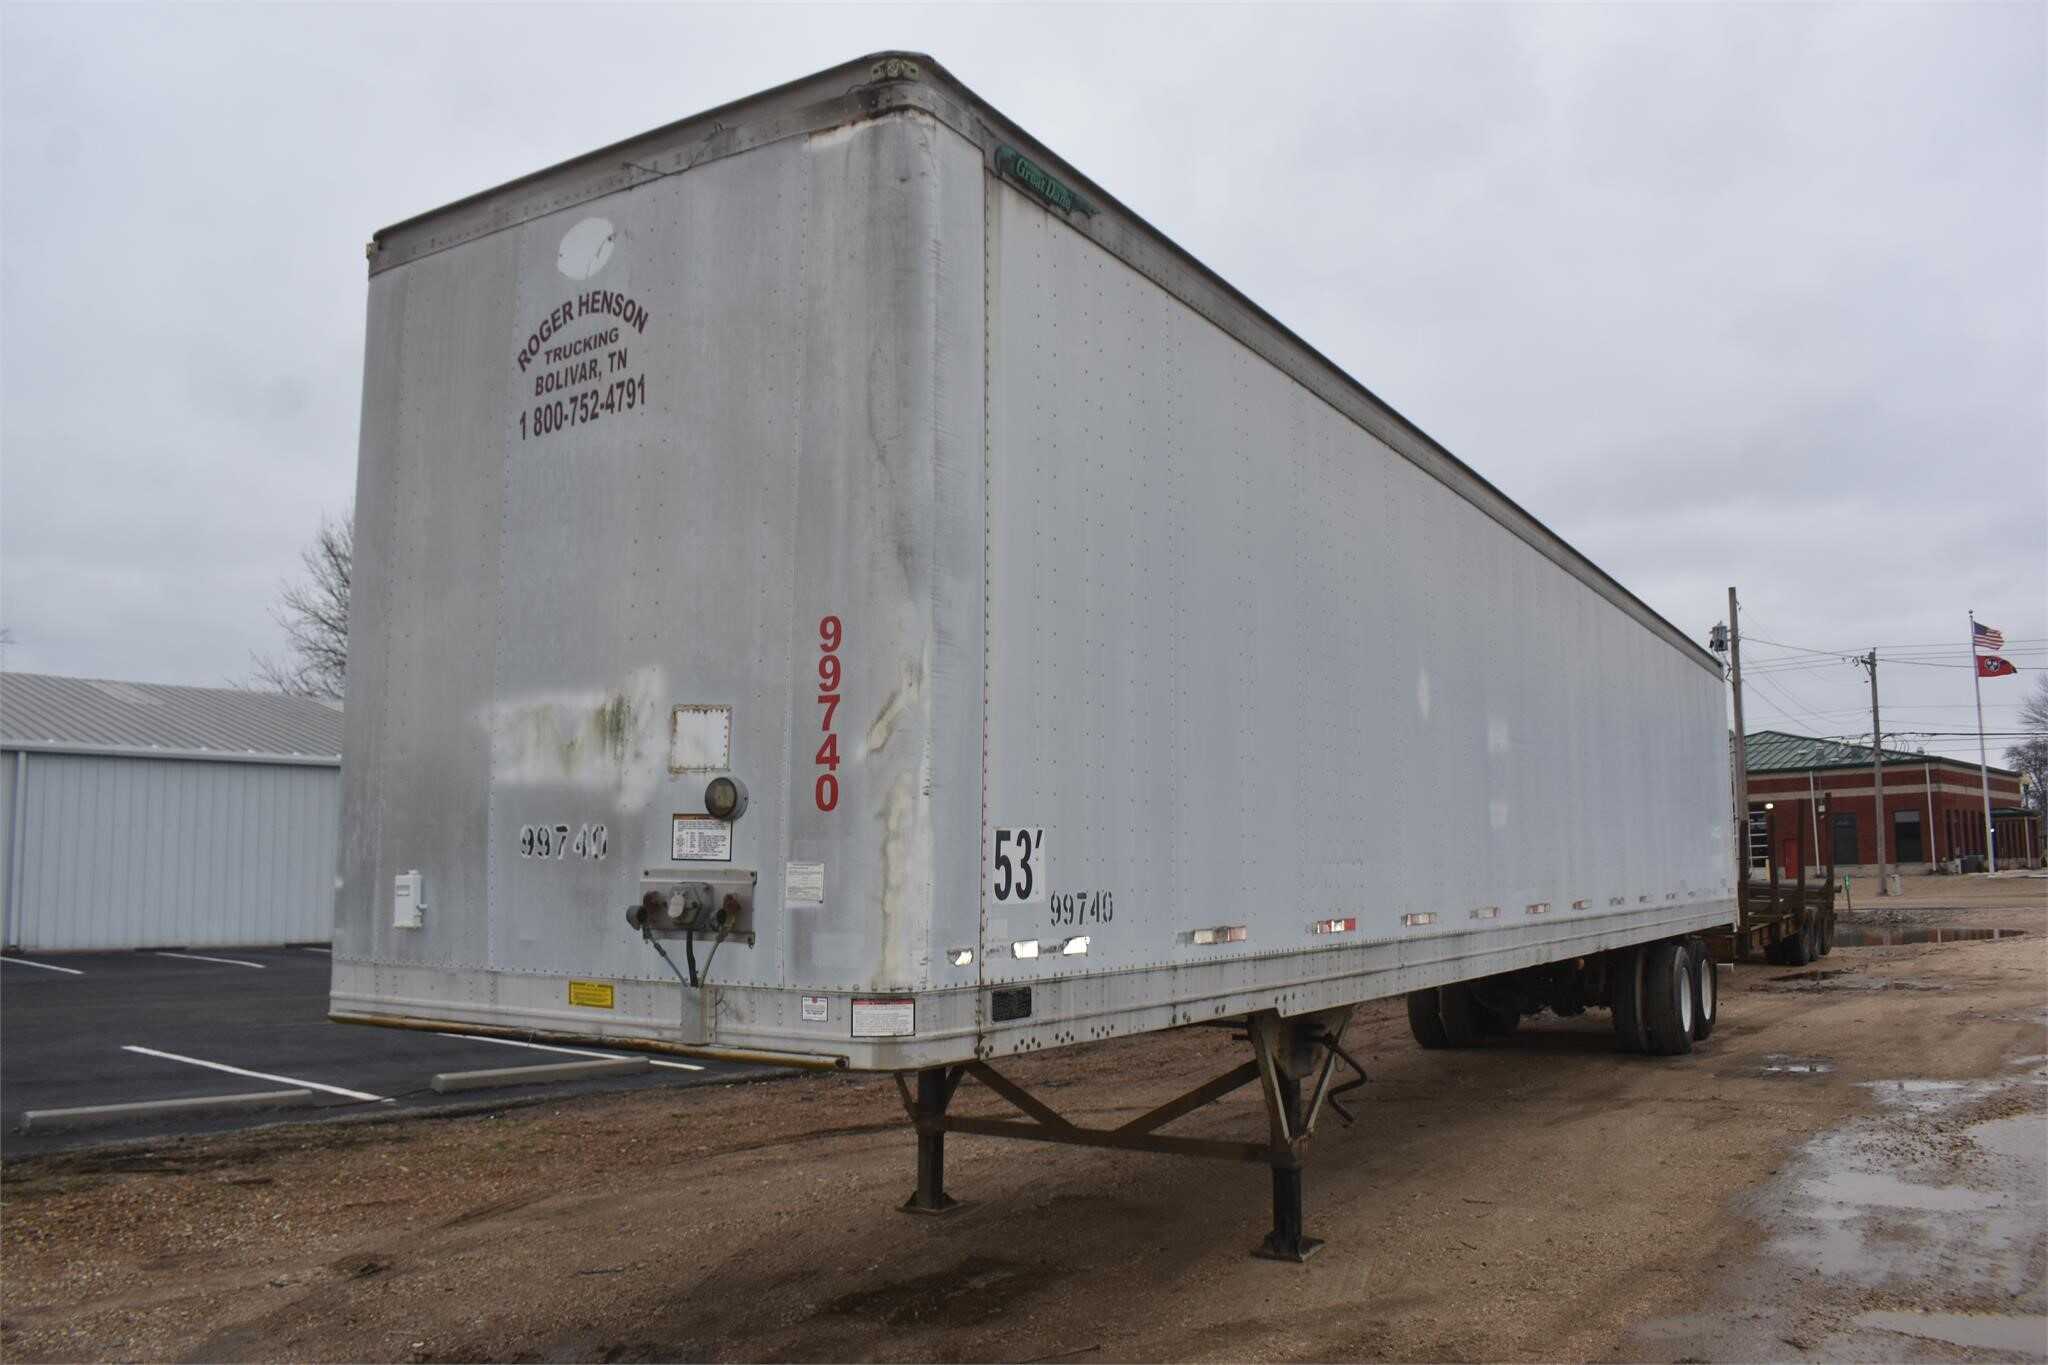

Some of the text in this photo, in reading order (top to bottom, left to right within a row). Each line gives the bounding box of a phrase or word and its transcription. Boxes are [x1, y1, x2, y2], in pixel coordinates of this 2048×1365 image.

[517, 290, 649, 373] ROGER HENSON
[544, 327, 620, 365] TRUCKING
[534, 347, 628, 397] BOLIVAR, TN
[519, 373, 646, 441] 1 800-752-4791
[815, 615, 842, 812] 99740
[519, 825, 608, 860] 99740
[1050, 890, 1114, 926] 99740
